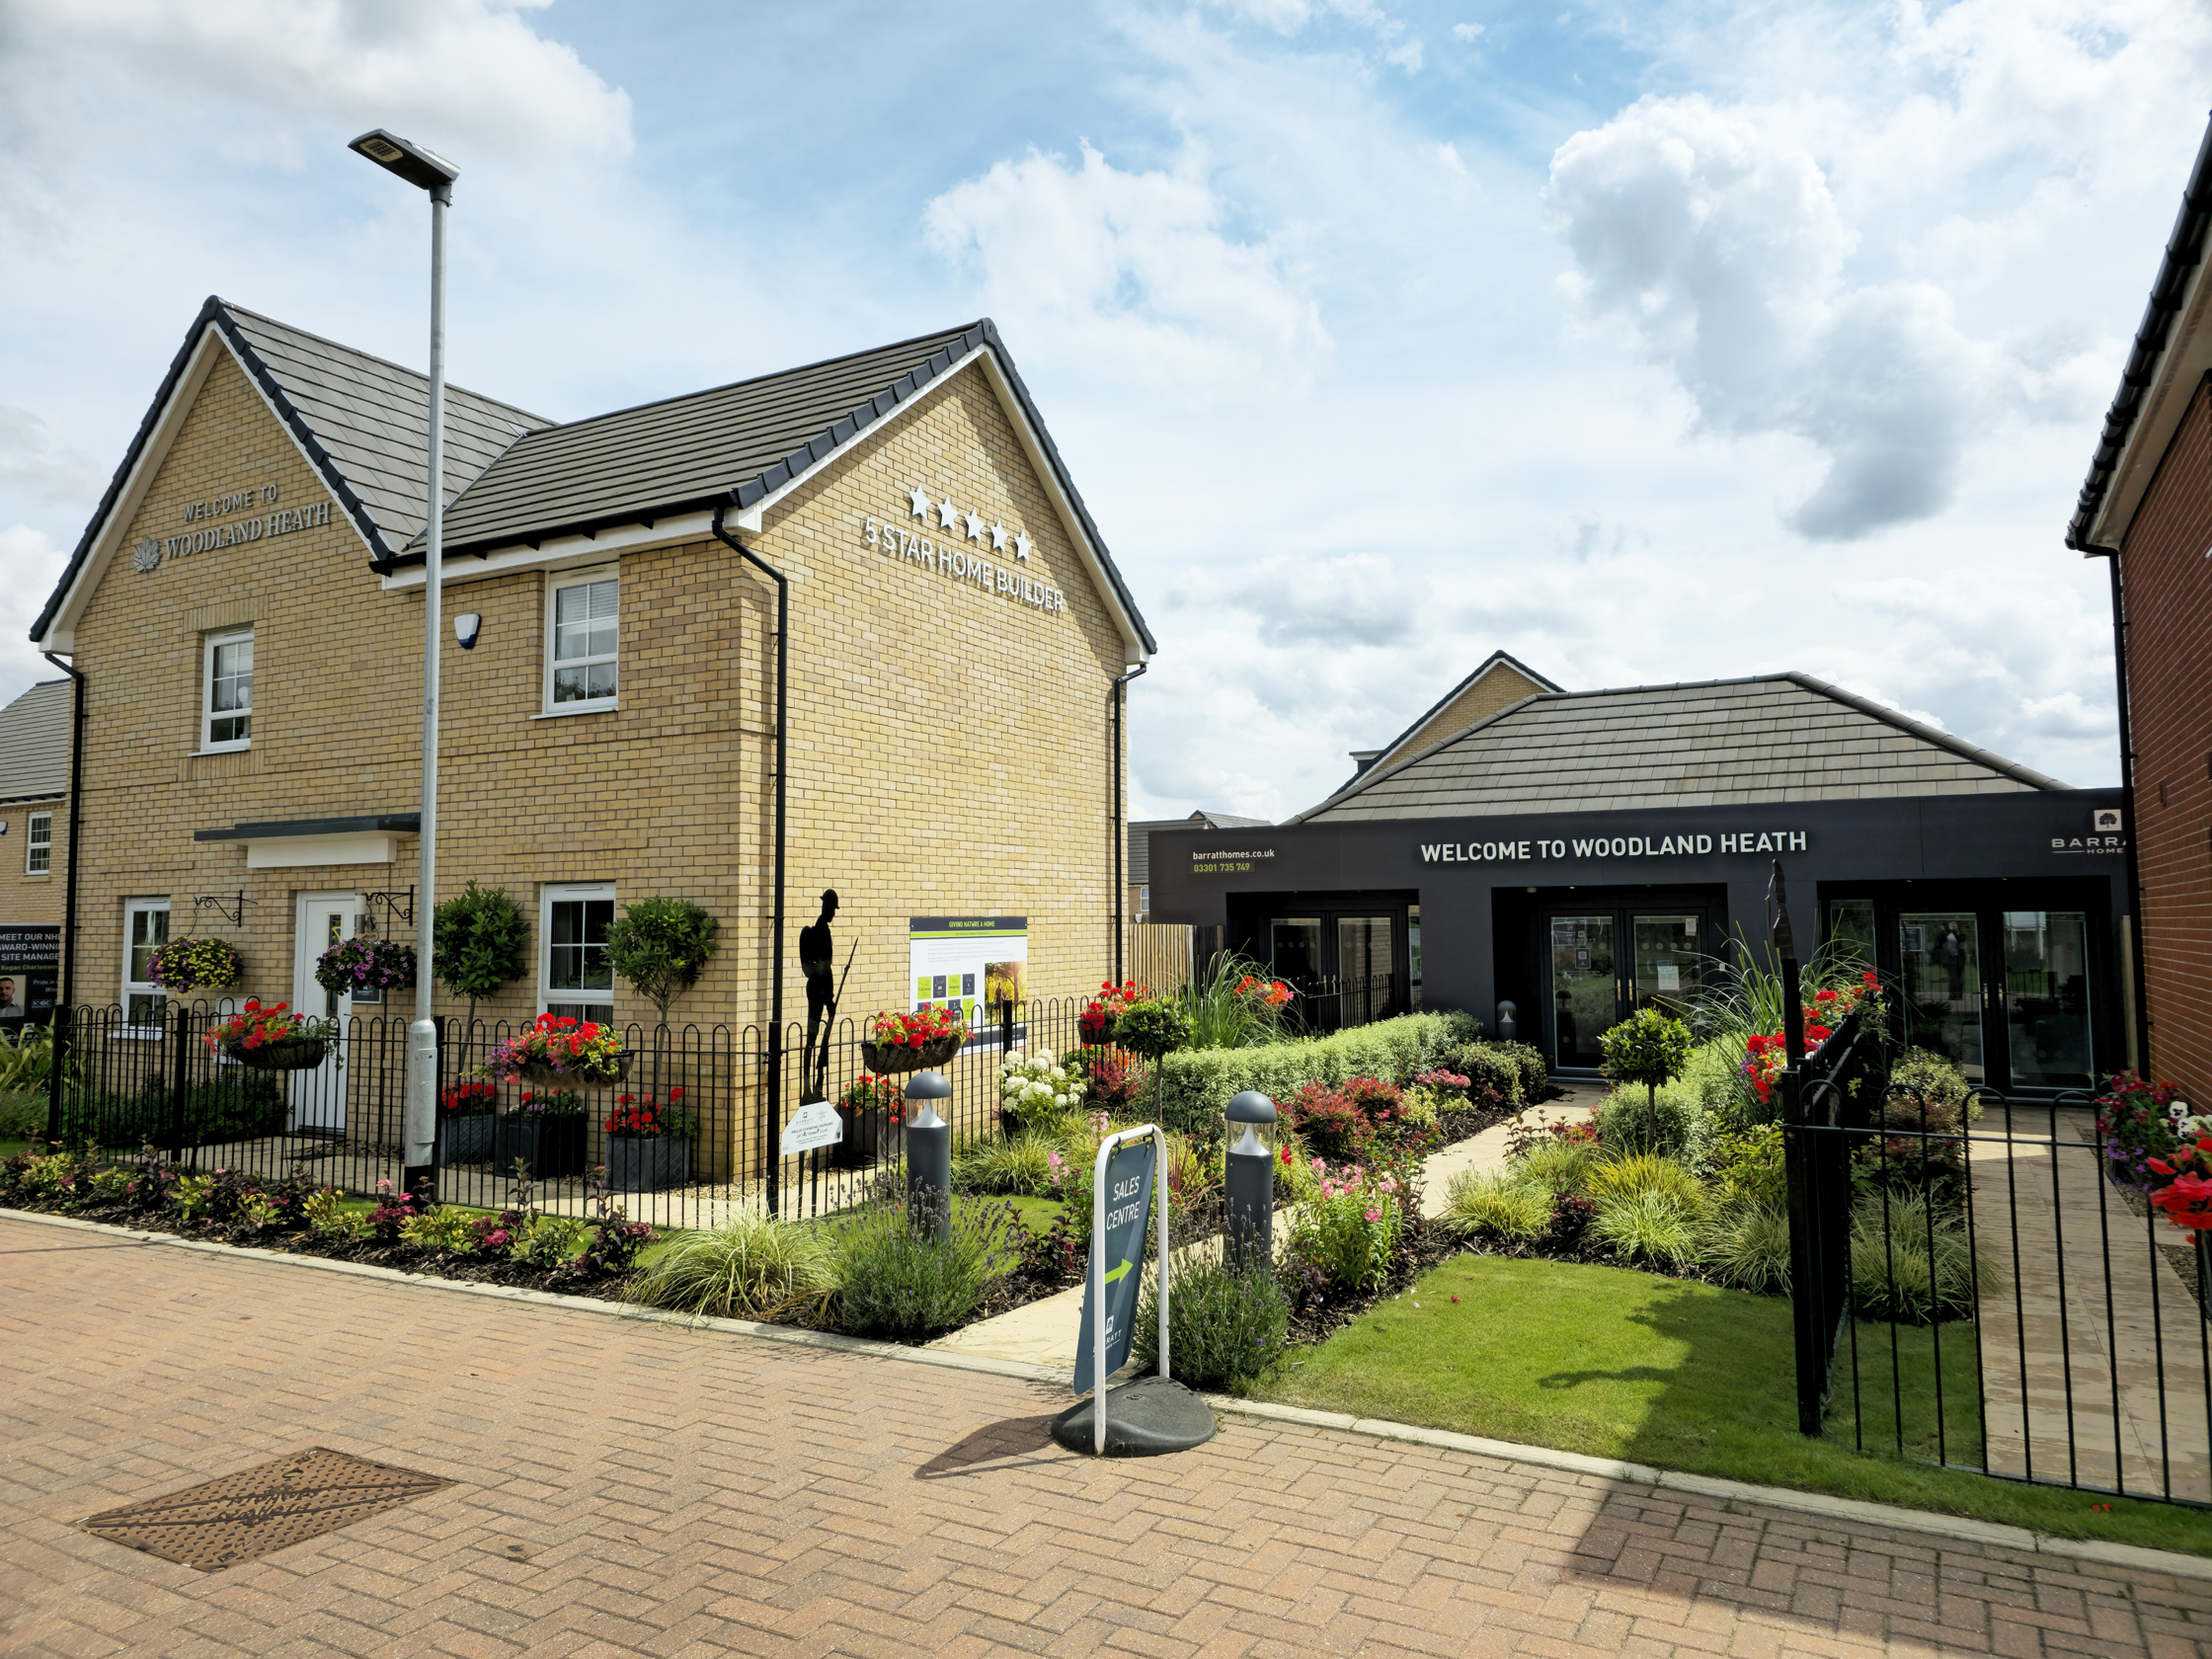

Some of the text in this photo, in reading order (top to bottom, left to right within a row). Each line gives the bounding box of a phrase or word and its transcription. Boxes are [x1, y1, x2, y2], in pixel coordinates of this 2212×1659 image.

[184, 484, 277, 521] WELCOME TO
[165, 502, 331, 559] WOODLAND HEATH
[865, 516, 1064, 612] 5 STAR HOME BUILDER
[1192, 849, 1275, 860] barratthomes.co.uk
[1420, 831, 1807, 862] WELCOME TO WOODLAND HEATH
[2051, 836, 2127, 847] BARR
[1193, 862, 1250, 872] 03301 735 749
[1113, 1175, 1141, 1201] SALES
[1106, 1201, 1141, 1230] CENTRE
